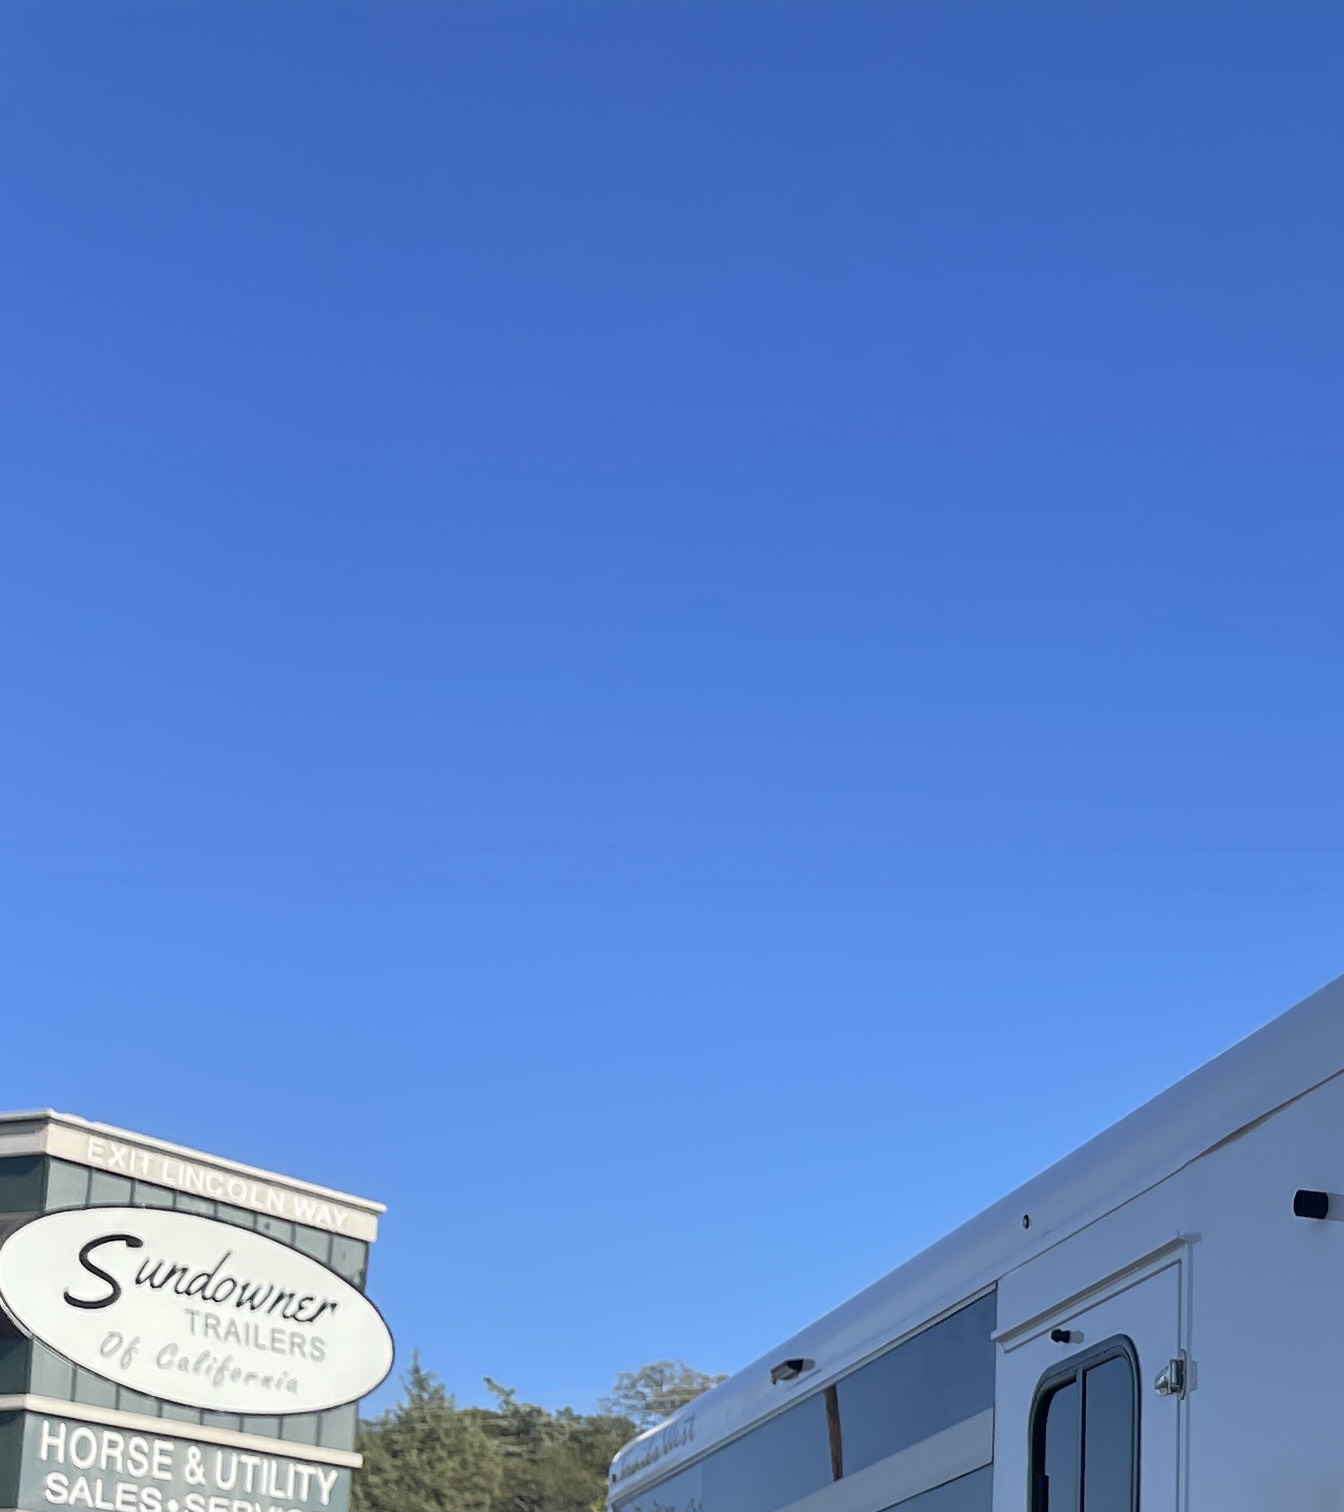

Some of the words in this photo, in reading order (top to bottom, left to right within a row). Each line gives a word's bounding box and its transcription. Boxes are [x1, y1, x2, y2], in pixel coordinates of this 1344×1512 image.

[87, 1136, 153, 1175] EXIT
[161, 1159, 285, 1211] LINCOLN
[293, 1197, 348, 1228] WAY
[63, 1234, 338, 1323] Sundowner
[99, 1331, 141, 1370] Of
[156, 1343, 299, 1395] California
[184, 1307, 327, 1363] TRAILERS
[39, 1420, 175, 1482] HORSE
[184, 1445, 206, 1486] &
[215, 1450, 338, 1506] UTILITY
